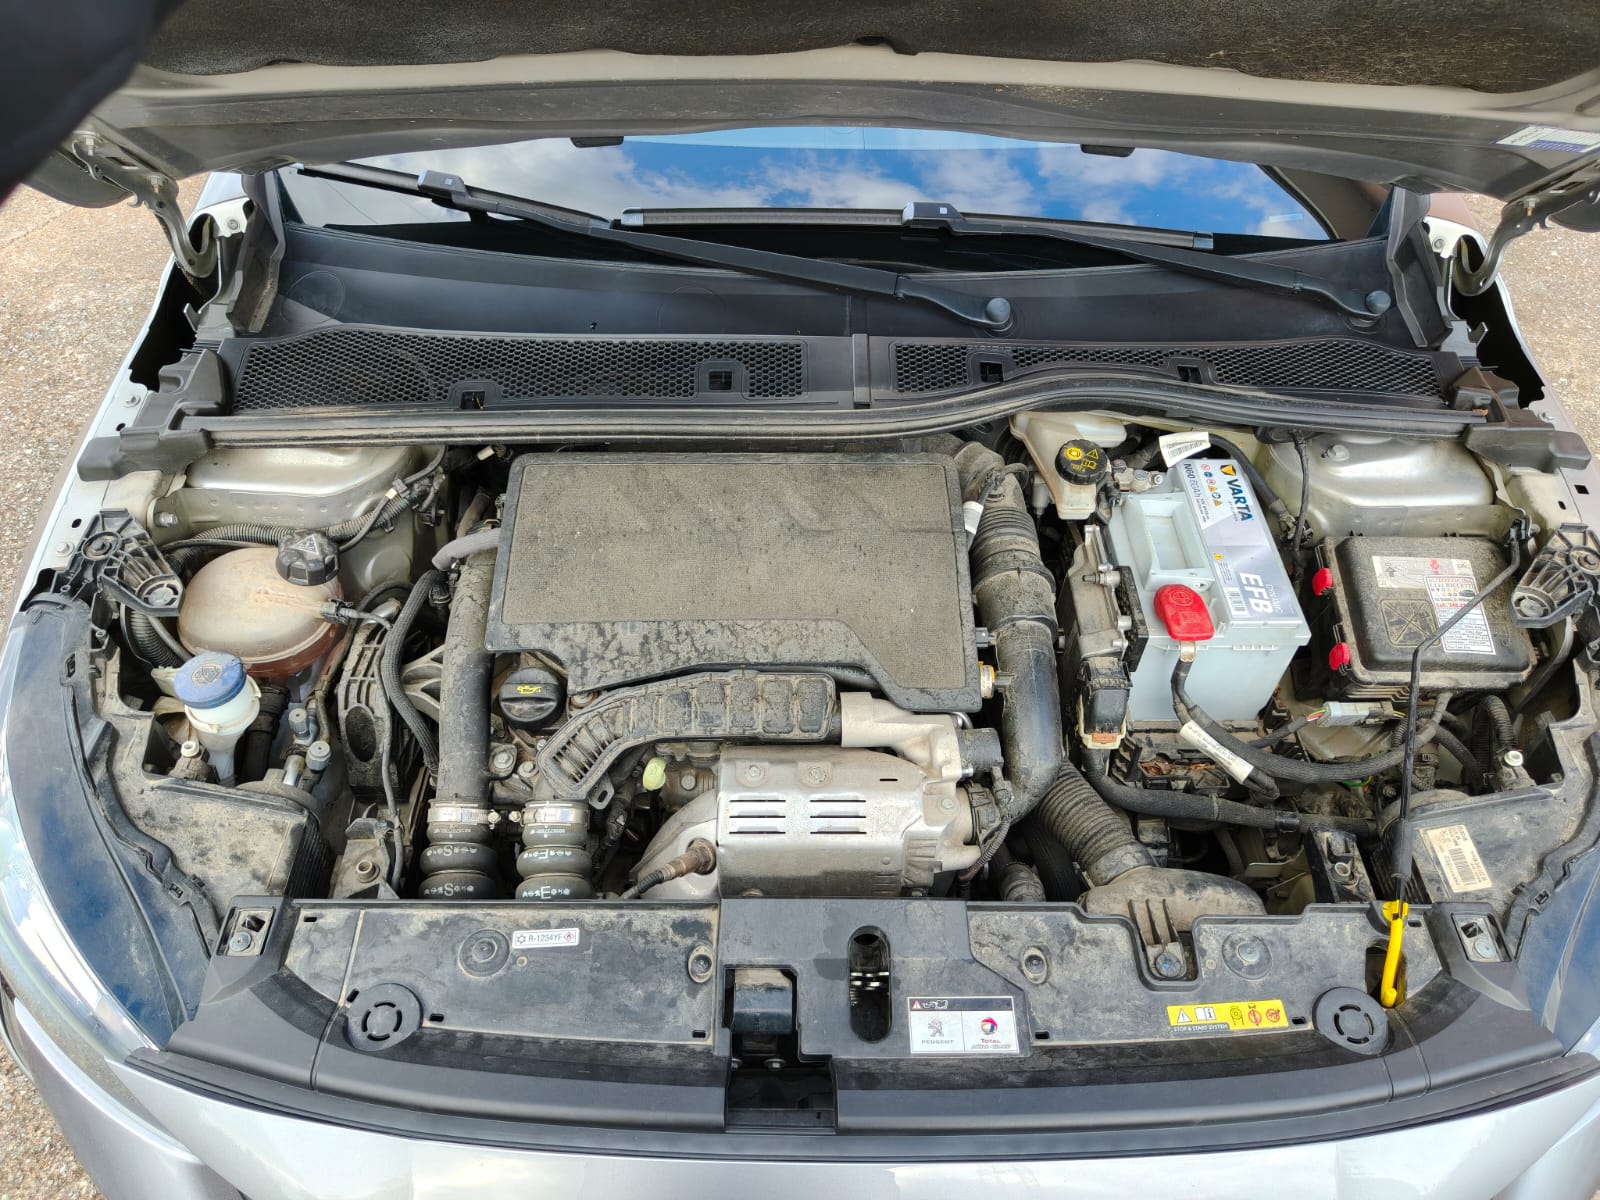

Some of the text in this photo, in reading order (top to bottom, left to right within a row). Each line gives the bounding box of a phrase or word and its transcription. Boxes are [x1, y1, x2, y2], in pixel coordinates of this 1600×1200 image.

[1183, 463, 1196, 479] N60
[1226, 478, 1254, 521] VARTA
[1240, 572, 1273, 614] EFB
